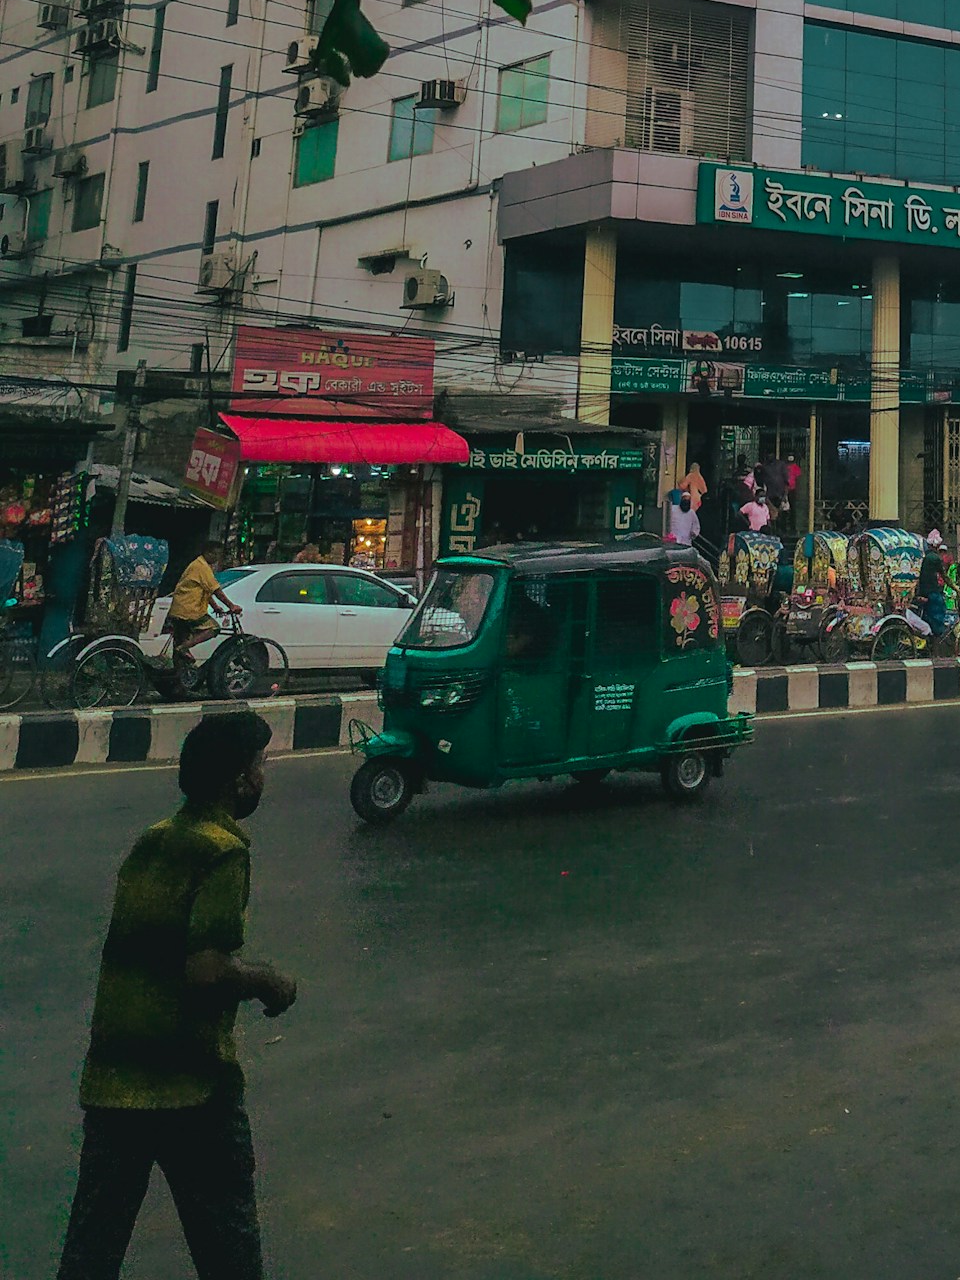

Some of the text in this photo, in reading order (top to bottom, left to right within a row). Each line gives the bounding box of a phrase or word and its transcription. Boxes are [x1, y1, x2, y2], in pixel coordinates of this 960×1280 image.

[718, 210, 749, 220] IBN SINA
[765, 177, 832, 224] ইবনে
[841, 187, 895, 229] সিনা
[905, 194, 938, 233] ডি.
[612, 323, 763, 351] ইবনে সিনা 10615
[301, 350, 376, 369] HAQUE
[489, 448, 519, 470] ভাই
[521, 449, 579, 469] মেডিসিন
